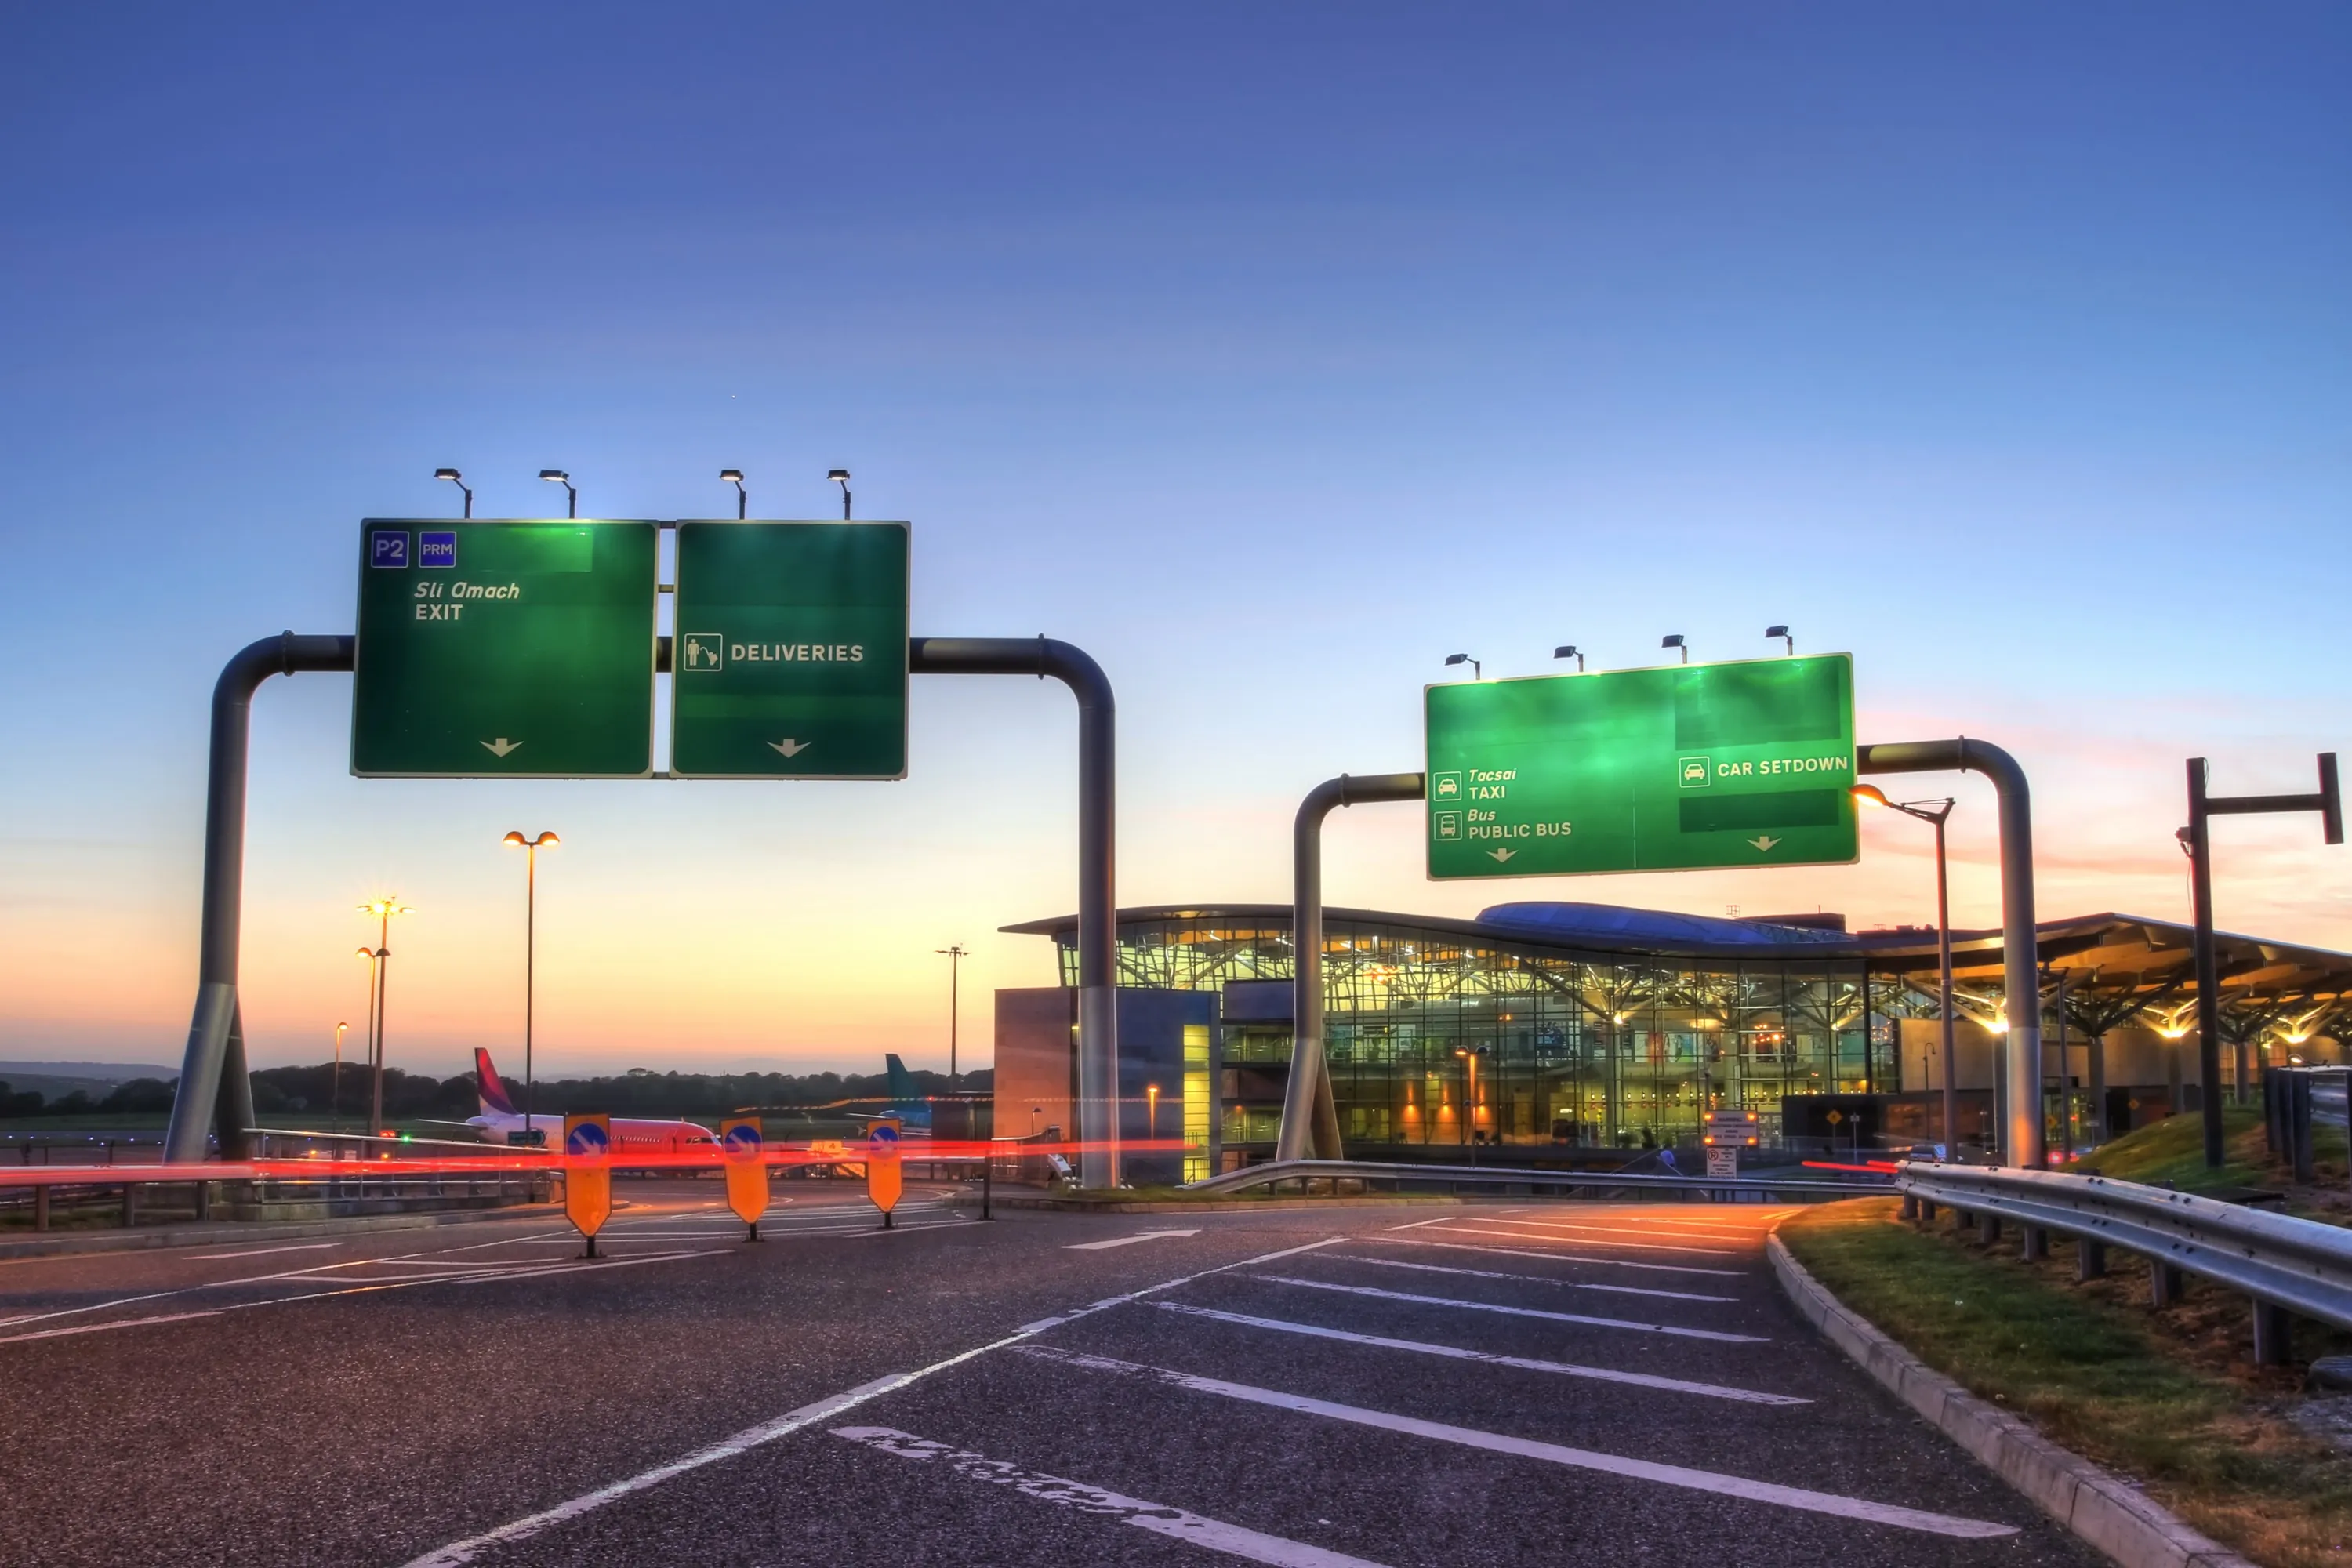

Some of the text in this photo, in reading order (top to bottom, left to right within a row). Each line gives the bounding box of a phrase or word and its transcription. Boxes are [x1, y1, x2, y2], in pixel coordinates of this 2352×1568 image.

[376, 539, 404, 557] P2
[423, 543, 453, 555] PRM
[416, 604, 463, 620] EXIT
[731, 644, 864, 662] DELIVERIES
[1718, 757, 1848, 777] CAR SETDOWN
[1468, 786, 1505, 800] TAXI
[1468, 809, 1496, 822] Bus
[1469, 822, 1572, 839] PUBLIC BUS
